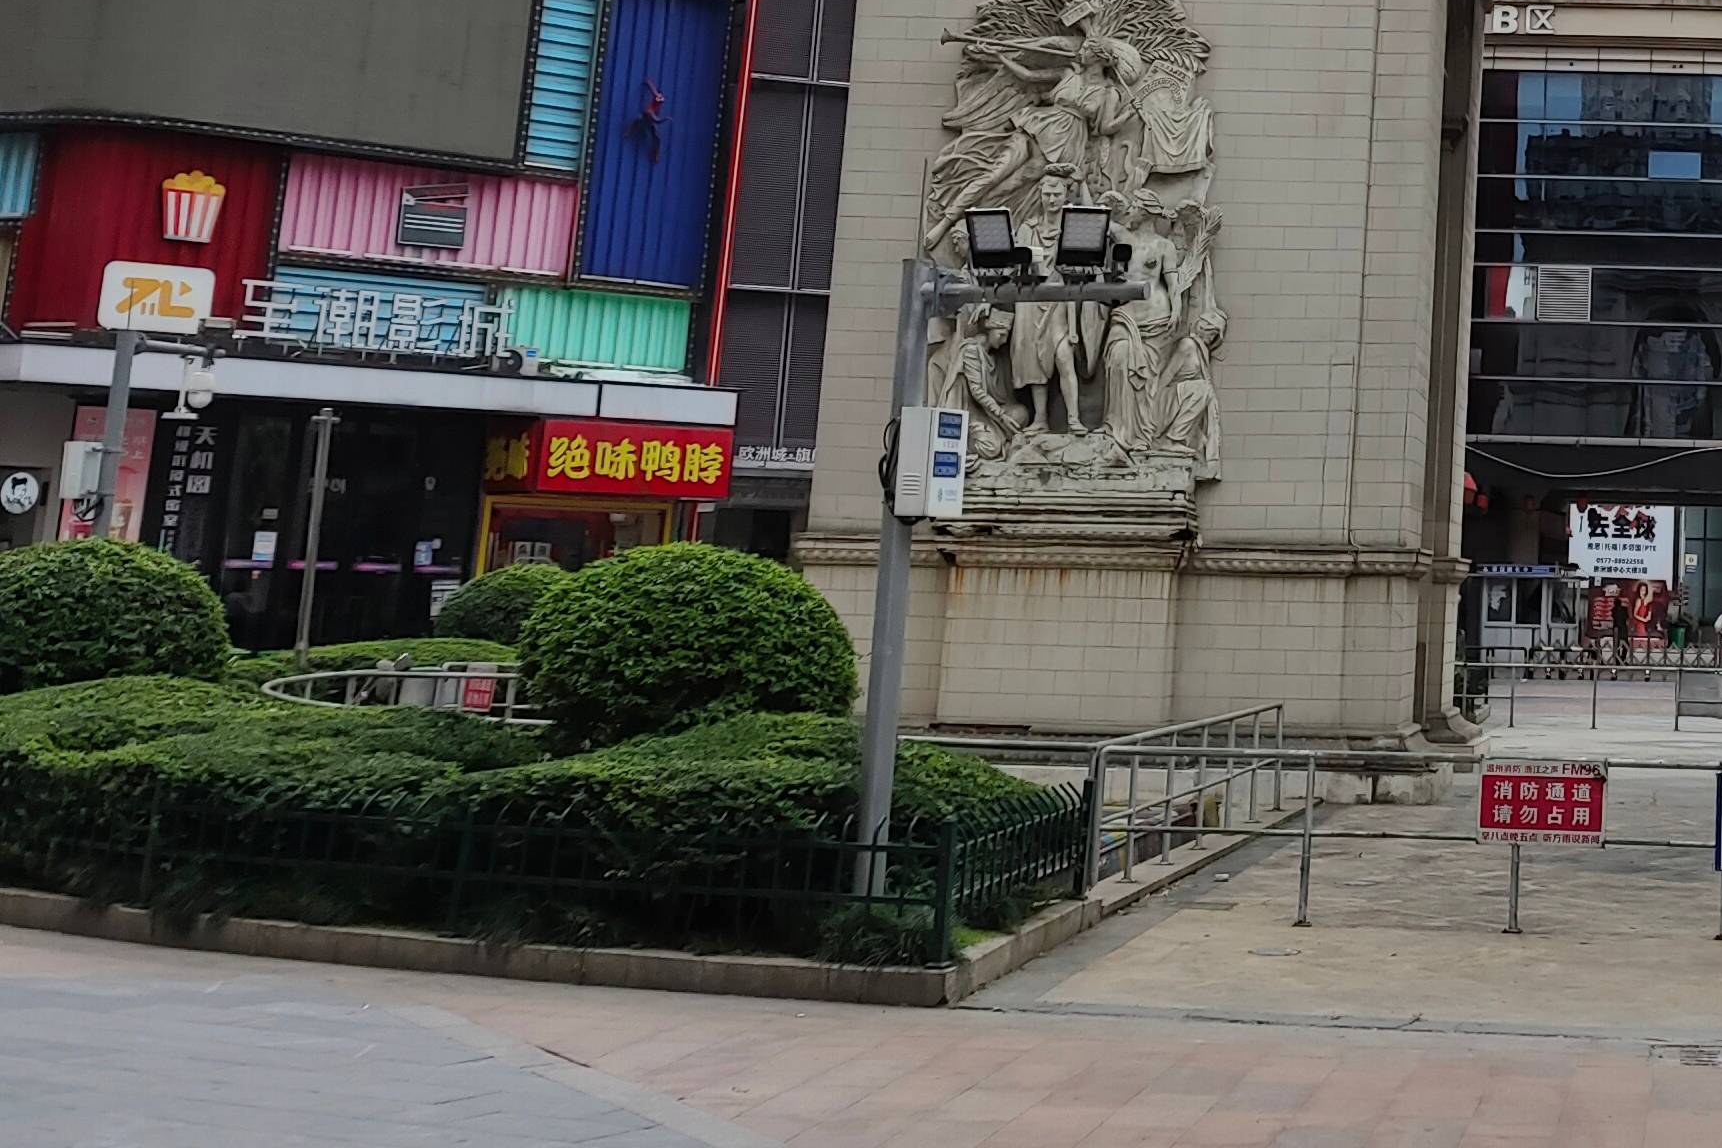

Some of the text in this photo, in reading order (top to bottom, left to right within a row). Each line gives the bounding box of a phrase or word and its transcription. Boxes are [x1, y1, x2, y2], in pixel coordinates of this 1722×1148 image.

[1493, 4, 1555, 35] B区
[547, 434, 724, 484] 绝味鸭脖
[1493, 780, 1592, 803] 消防通道
[1492, 804, 1590, 826] 请勿占用
